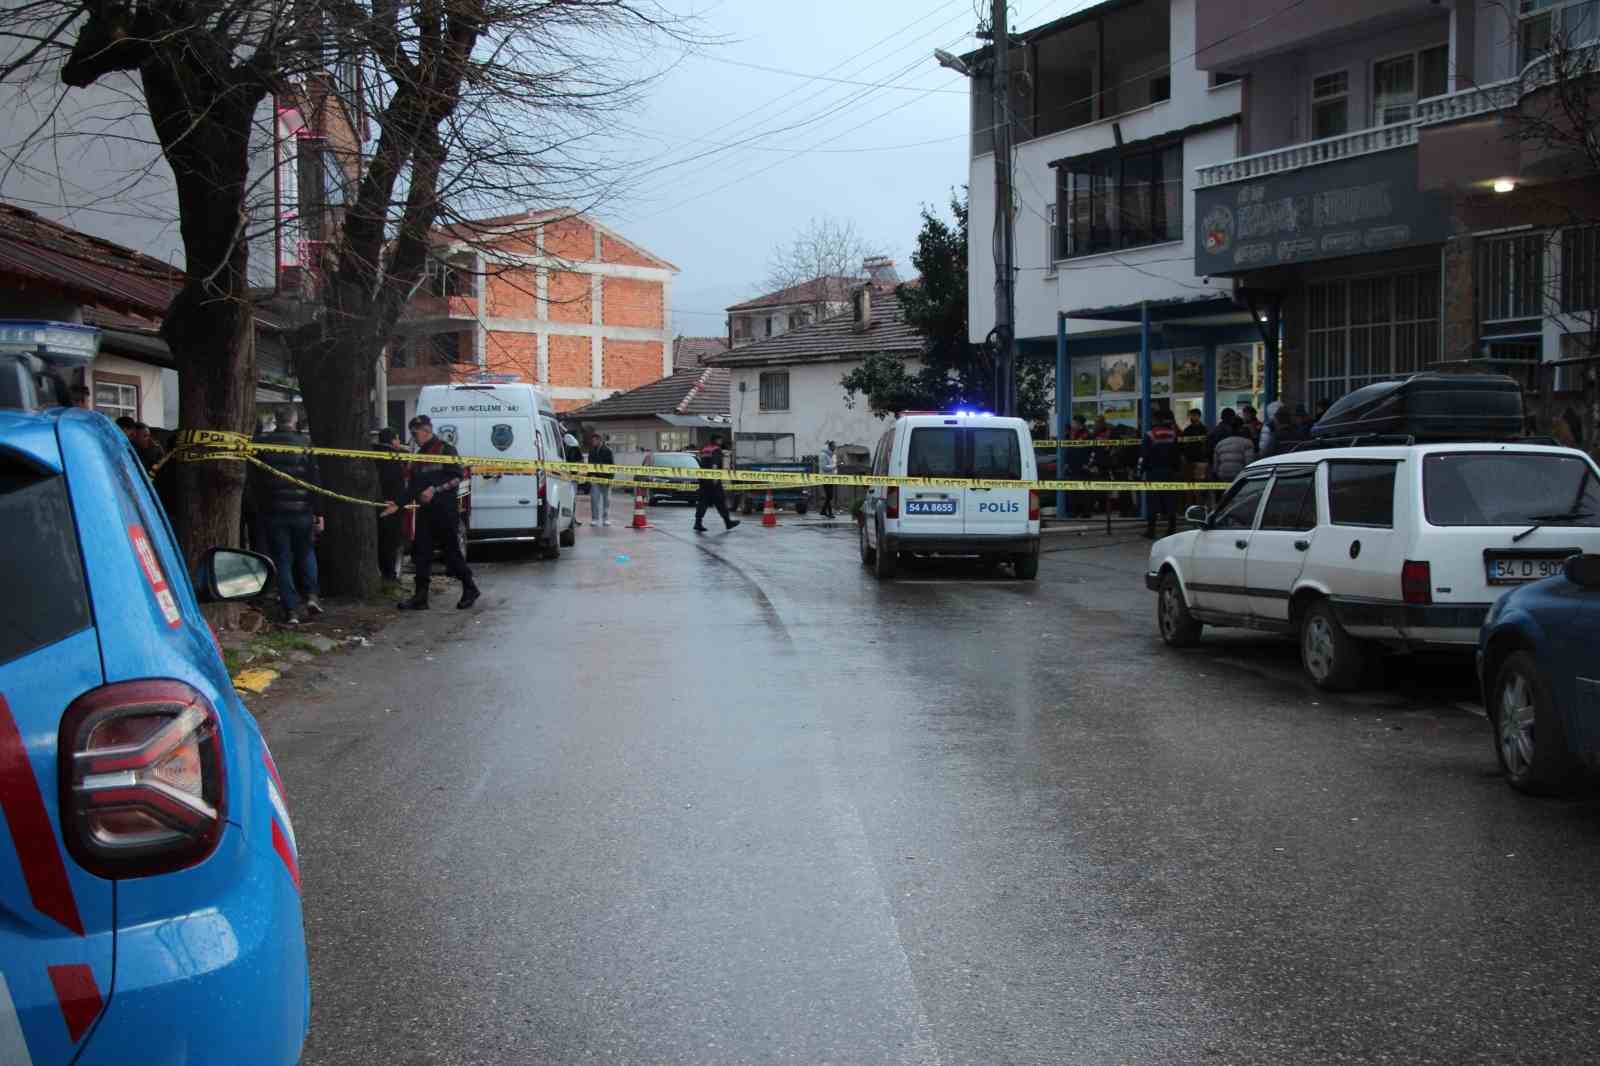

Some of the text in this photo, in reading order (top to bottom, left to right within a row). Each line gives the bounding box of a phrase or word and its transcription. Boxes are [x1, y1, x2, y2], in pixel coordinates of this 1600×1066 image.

[909, 503, 920, 512] 54
[922, 503, 929, 512] A
[979, 500, 1019, 513] POLİS
[1496, 560, 1515, 577] 54
[1522, 560, 1533, 577] D
